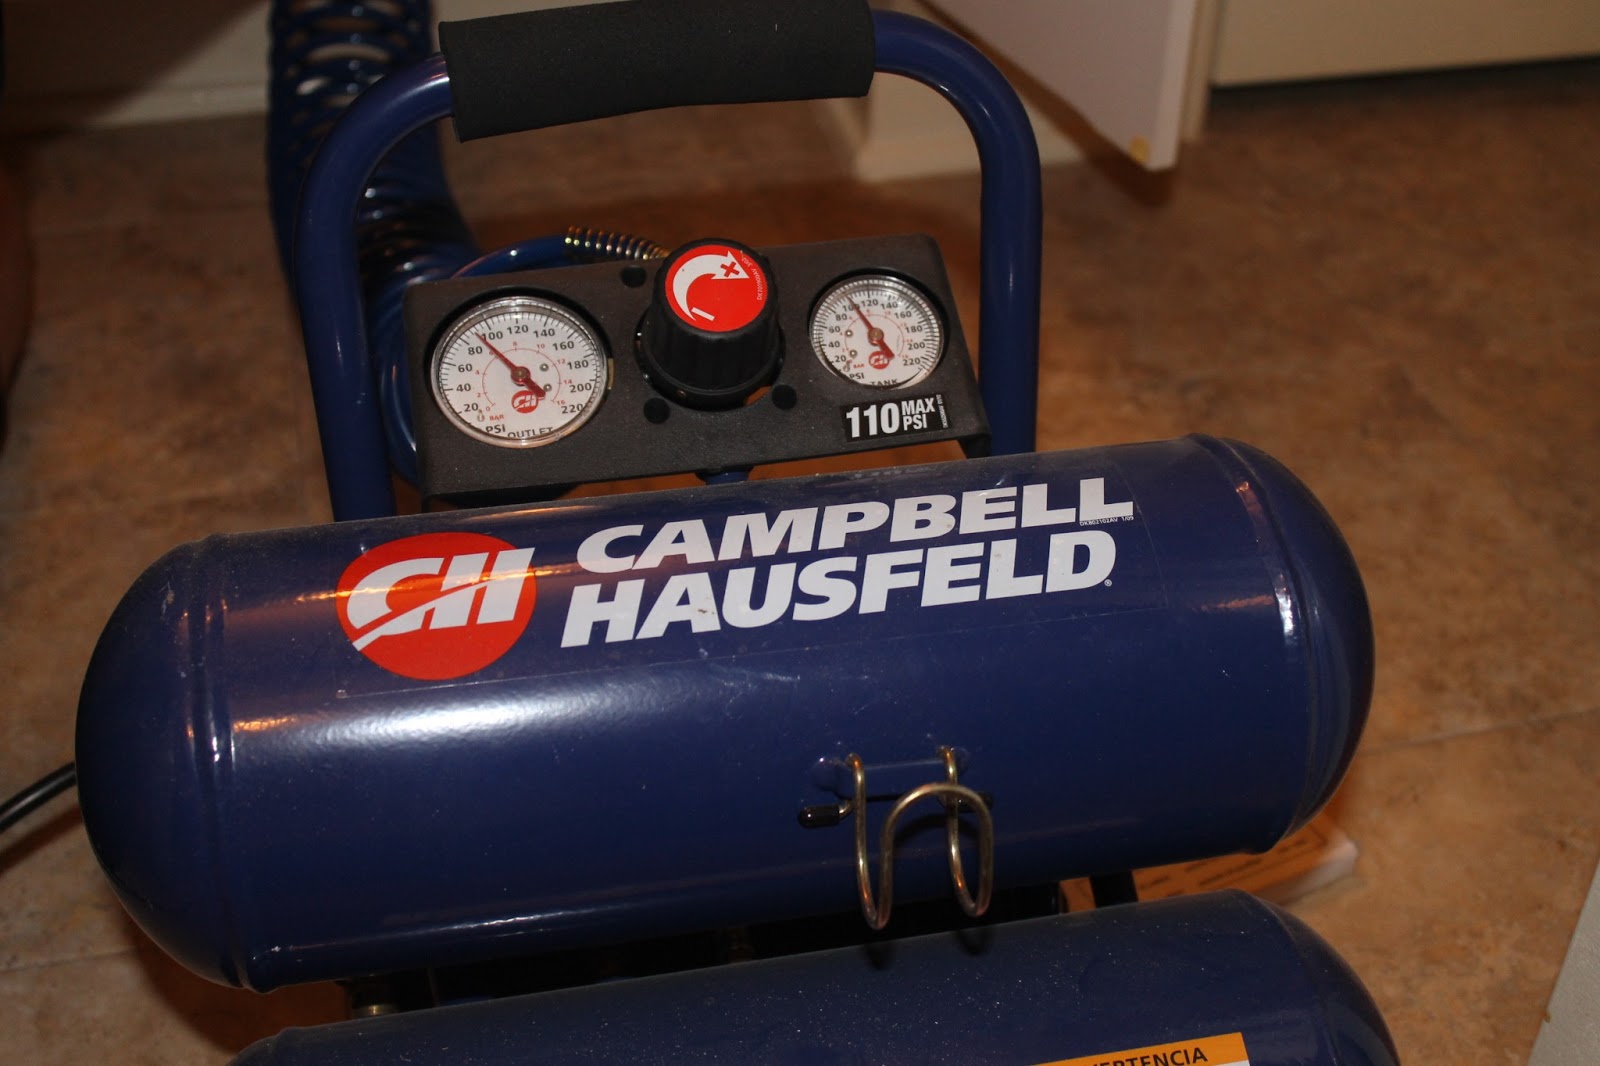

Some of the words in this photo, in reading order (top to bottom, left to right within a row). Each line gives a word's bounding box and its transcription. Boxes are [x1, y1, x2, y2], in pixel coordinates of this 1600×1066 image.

[861, 299, 879, 308] 120
[881, 301, 898, 310] 140
[835, 313, 847, 321] 80
[894, 311, 912, 319] 160
[506, 324, 529, 335] 120
[532, 328, 555, 339] 140
[905, 325, 922, 334] 180
[482, 331, 503, 342] 100
[467, 346, 483, 356] 80
[552, 341, 575, 351] 160
[907, 342, 926, 351] 200
[567, 360, 589, 370] 180
[902, 358, 921, 366] 220
[458, 363, 473, 373] 60
[849, 372, 865, 380] PSI
[870, 378, 898, 386] TANK
[456, 383, 471, 393] 40
[569, 382, 592, 393] 200
[464, 402, 479, 412] 20
[561, 403, 583, 414] 220
[846, 402, 900, 438] 110
[901, 397, 936, 415] MAX
[902, 413, 928, 431] PSI
[485, 424, 506, 434] PSI
[507, 427, 553, 439] OUTLET
[575, 477, 1133, 573] CAMPBELL
[560, 531, 1117, 648] HAUSFELD
[347, 547, 535, 651] CH
